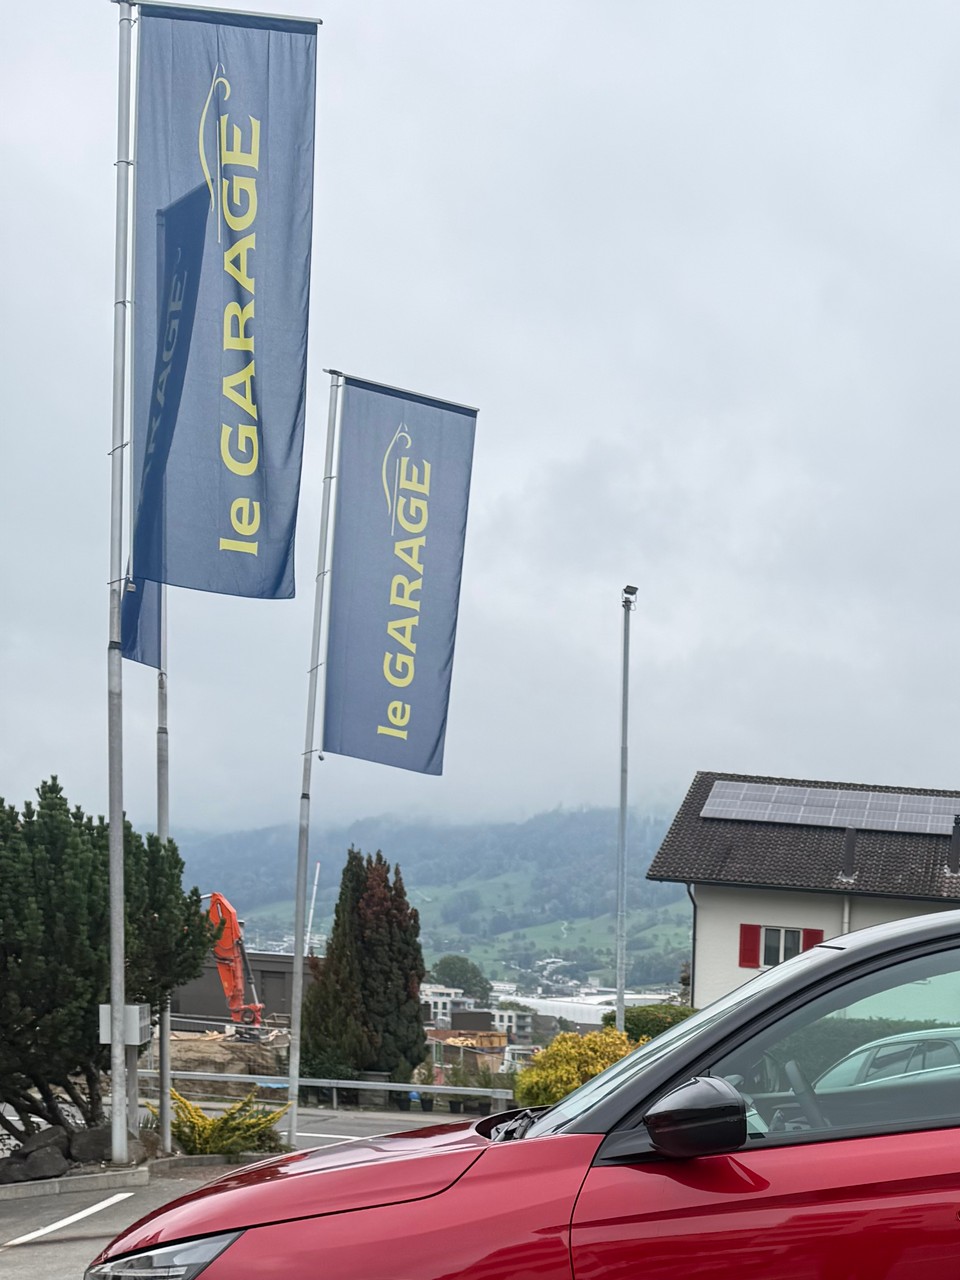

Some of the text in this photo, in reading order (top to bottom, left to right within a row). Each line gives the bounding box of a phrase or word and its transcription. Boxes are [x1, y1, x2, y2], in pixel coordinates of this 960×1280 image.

[219, 114, 261, 556] le GARAGE
[376, 456, 432, 740] le GARAGE
